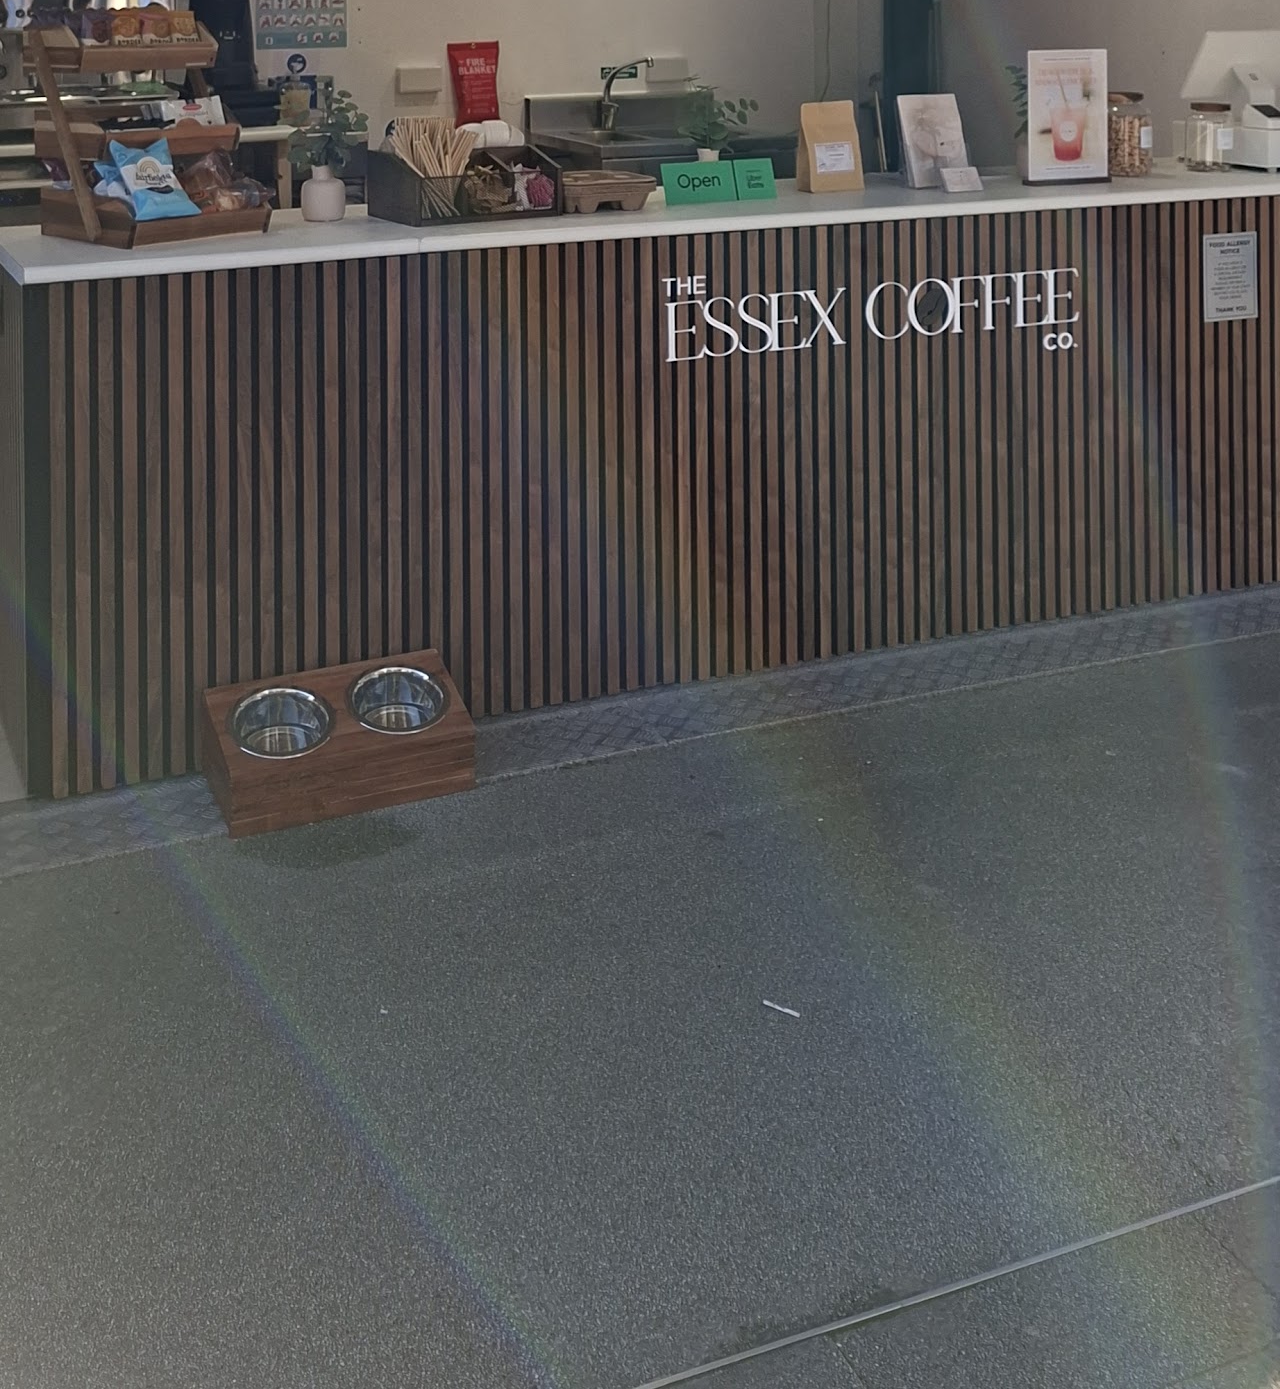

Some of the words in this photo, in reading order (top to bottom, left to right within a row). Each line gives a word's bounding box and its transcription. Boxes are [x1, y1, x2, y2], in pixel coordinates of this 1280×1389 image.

[458, 65, 496, 76] BLANKET
[466, 57, 485, 67] FIRE
[677, 174, 721, 191] Open
[661, 275, 707, 297] THE
[665, 287, 846, 362] ESSEX
[865, 268, 1080, 340] COFFEE
[1043, 332, 1079, 351] CO.
